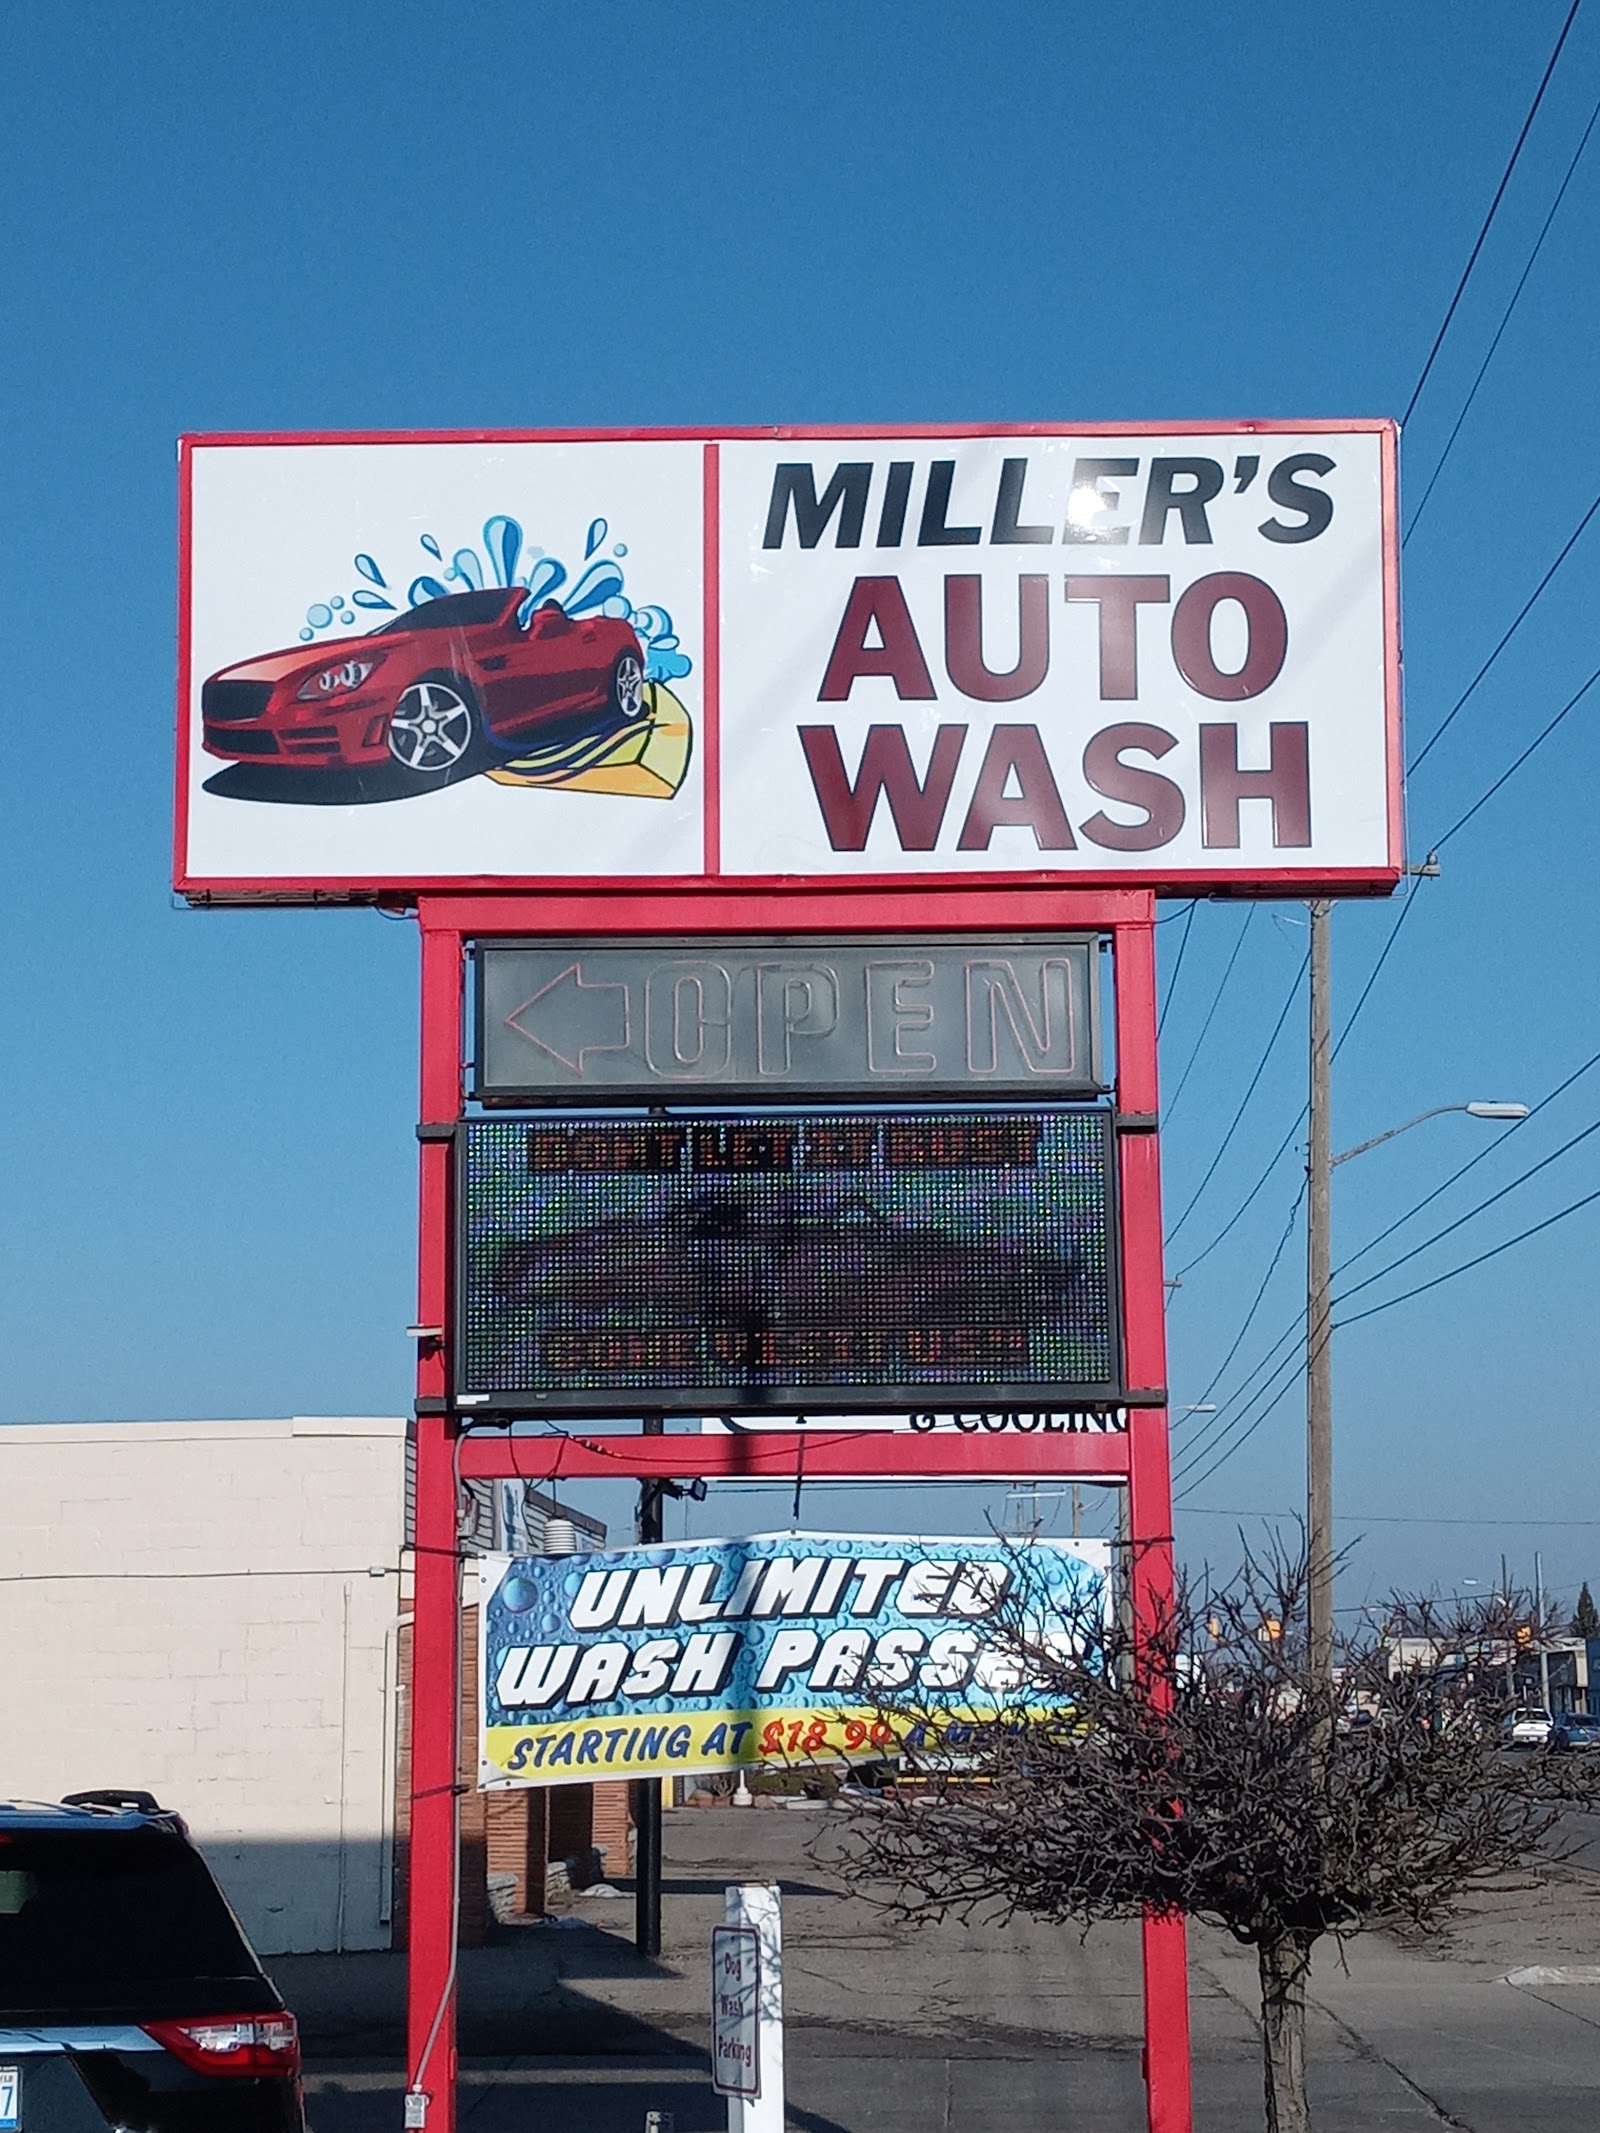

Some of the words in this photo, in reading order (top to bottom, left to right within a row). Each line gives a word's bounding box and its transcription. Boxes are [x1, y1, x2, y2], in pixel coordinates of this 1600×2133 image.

[762, 453, 1338, 550] MILLER'S
[815, 571, 1289, 703] AUTO
[795, 721, 1312, 852] WASH
[644, 957, 1077, 1078] OPEN
[890, 1129, 1037, 1164] RUST
[568, 1556, 1013, 1632] UNLIMITED
[495, 1631, 743, 1709] WASH
[507, 1724, 693, 1770] STARTING
[701, 1721, 753, 1756] AT
[724, 1952, 742, 1982] Dog
[720, 1995, 744, 2018] Wash
[718, 2035, 752, 2068] Parking
